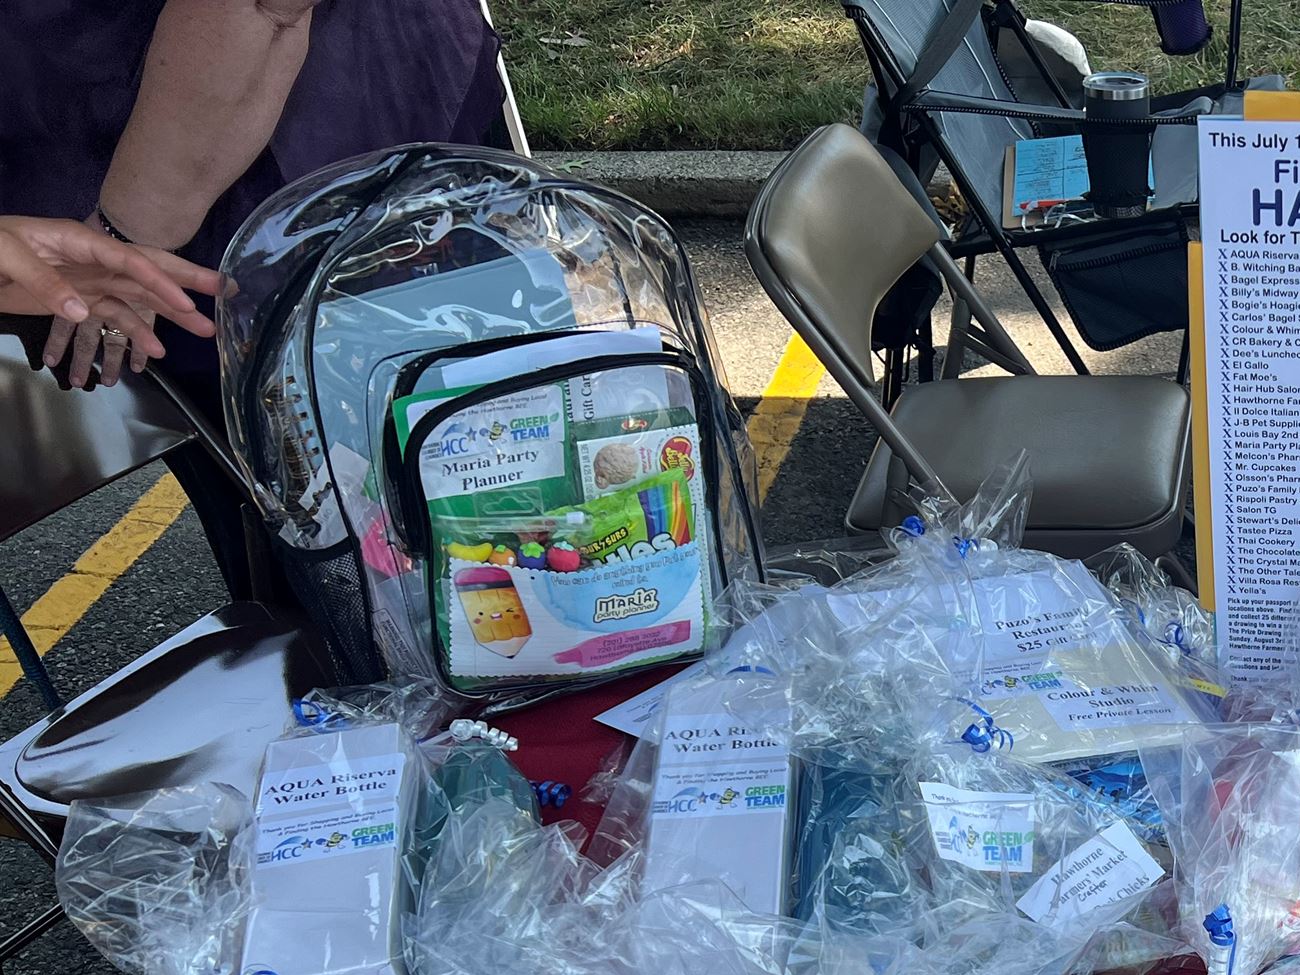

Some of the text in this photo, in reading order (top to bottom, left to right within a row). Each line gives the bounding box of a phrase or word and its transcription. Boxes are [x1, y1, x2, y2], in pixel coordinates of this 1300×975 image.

[1209, 133, 1246, 149] This
[1252, 134, 1288, 152] July
[1221, 230, 1255, 244] Look
[1260, 231, 1286, 245] for
[1231, 251, 1299, 260] AQUA Riserva
[1243, 264, 1285, 274] Witching
[1232, 276, 1299, 286] Bagel Express
[1232, 289, 1260, 298] Billy's
[1263, 290, 1298, 299] Midway
[1232, 302, 1267, 311] Bogie's
[1269, 314, 1295, 323] Bagel
[1232, 326, 1264, 334] Colour
[1249, 339, 1282, 348] Bakery
[1233, 350, 1259, 358] Dee's
[1244, 362, 1268, 370] Gallo
[1234, 397, 1284, 405] Hawthorne
[1235, 430, 1259, 438] Louis
[1262, 431, 1279, 440] Bay
[1281, 431, 1298, 439] 2nd
[442, 449, 538, 477] Maria Party
[462, 470, 523, 490] Planner
[599, 593, 654, 613] MARIA
[1017, 640, 1042, 652] $25
[1048, 688, 1096, 701] Colour
[1089, 698, 1134, 708] Studio
[265, 767, 396, 794] AQUA Riserva
[274, 781, 387, 804] Water Bottle
[352, 824, 394, 837] GREEN
[352, 833, 394, 847] TEAM
[1095, 850, 1128, 879] Market
[1116, 874, 1150, 902] Chicks
